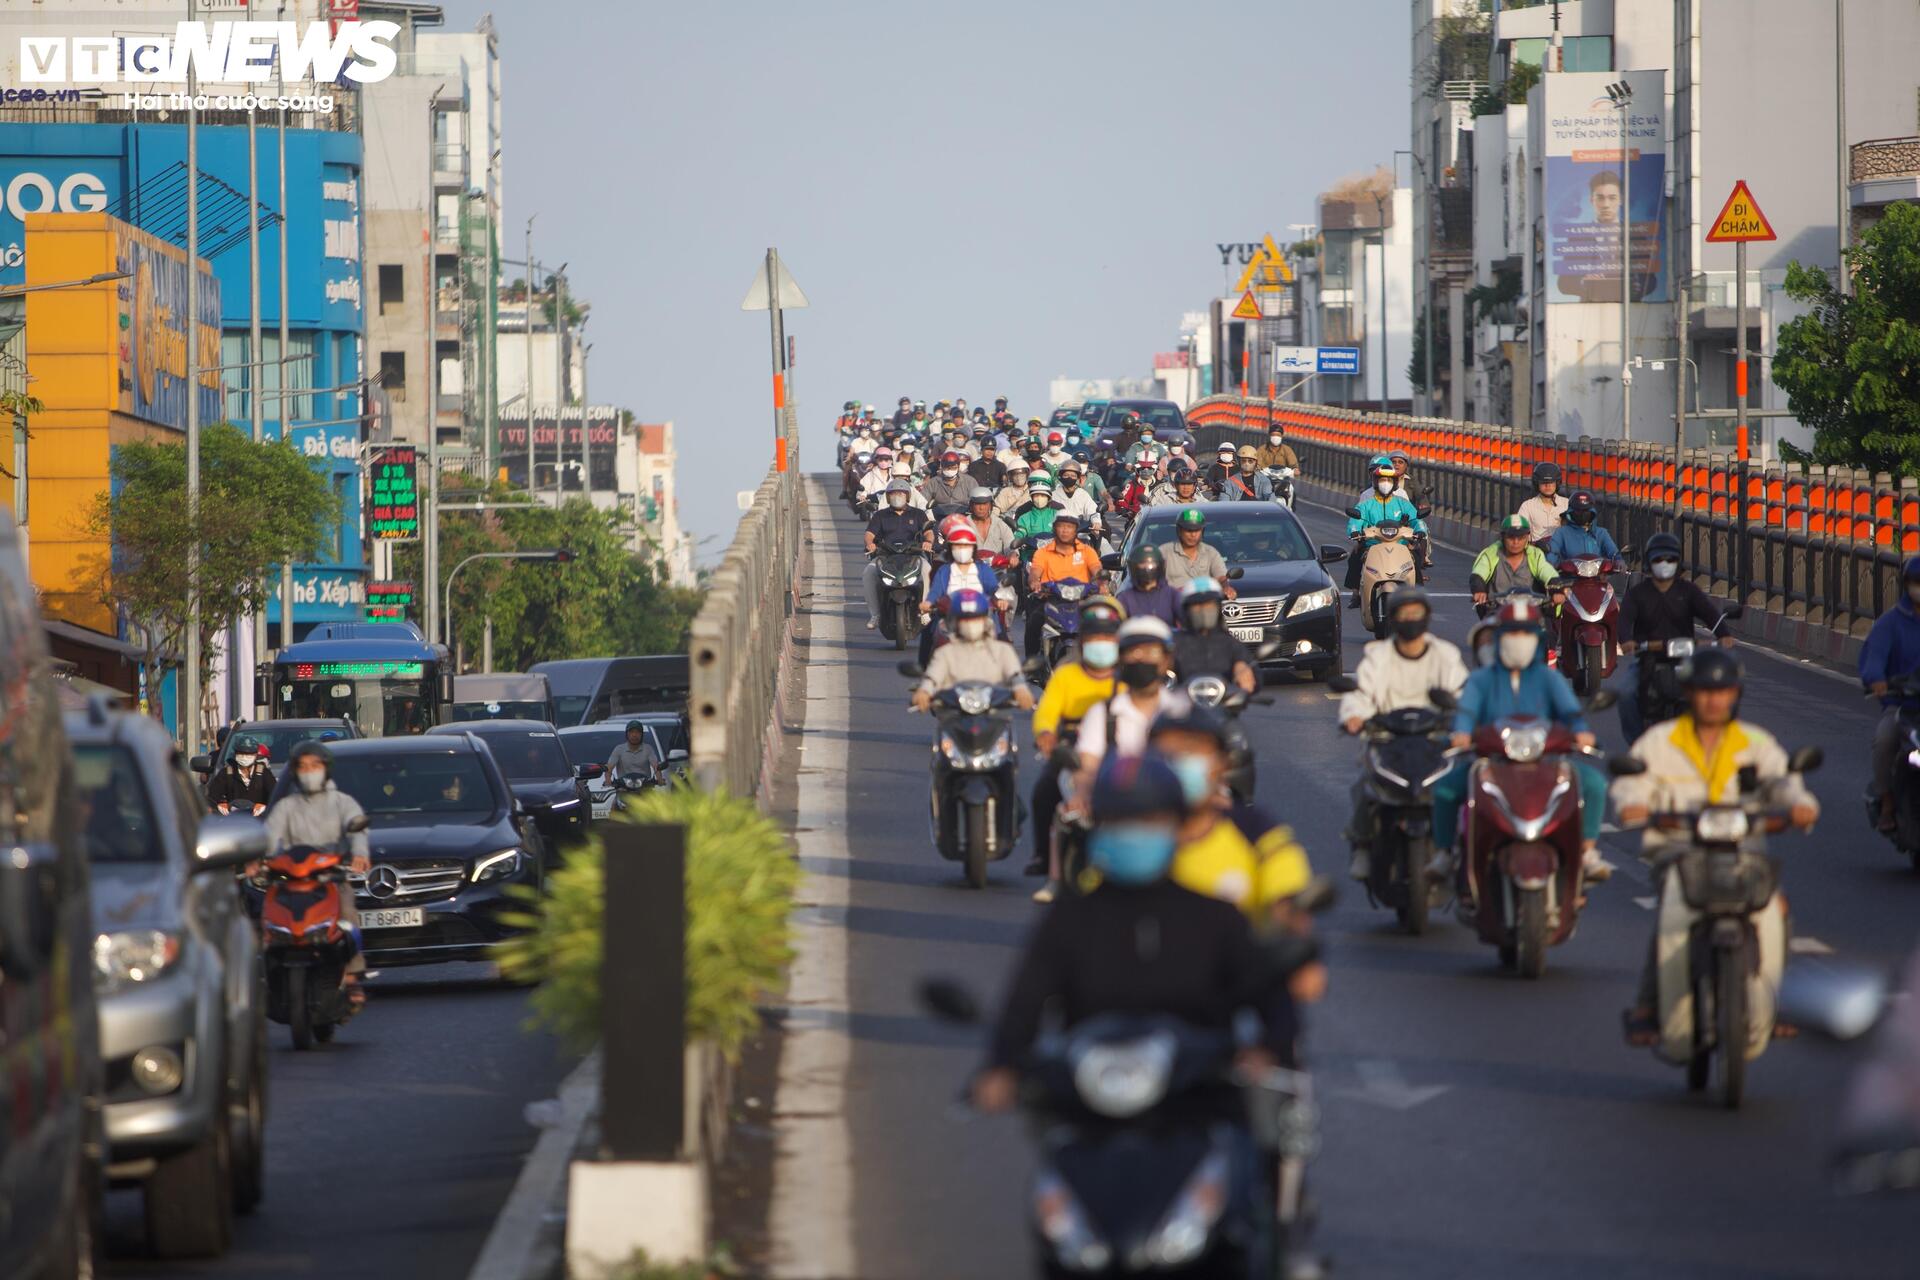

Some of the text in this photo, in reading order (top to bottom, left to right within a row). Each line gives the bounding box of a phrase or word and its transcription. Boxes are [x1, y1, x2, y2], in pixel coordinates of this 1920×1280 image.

[0, 88, 80, 105] cao.vn
[0, 172, 107, 222] OG
[1734, 204, 1747, 215] ĐI
[1721, 218, 1760, 236] CHẬM
[358, 911, 420, 927] 1F-896.04
